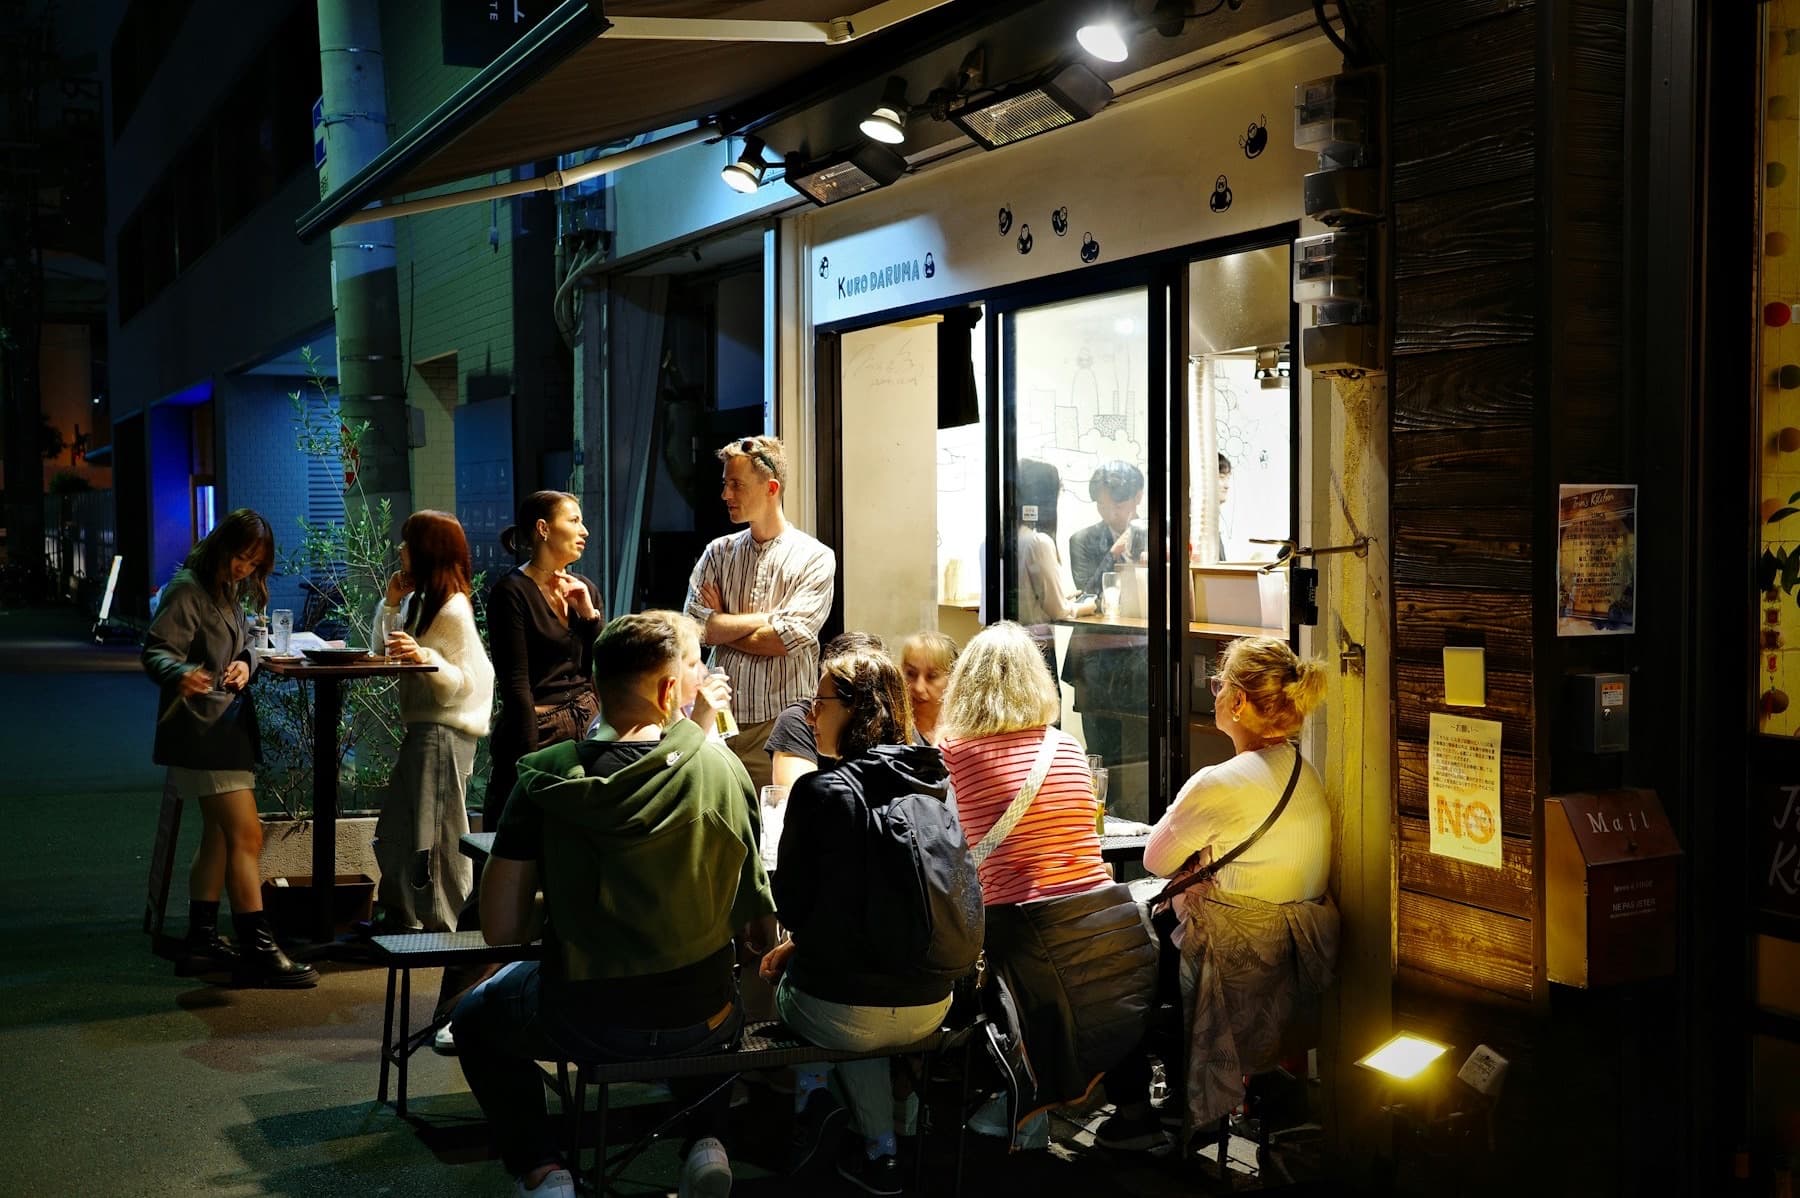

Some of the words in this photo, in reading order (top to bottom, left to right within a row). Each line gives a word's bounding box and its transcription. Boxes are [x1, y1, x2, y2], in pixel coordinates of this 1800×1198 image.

[870, 259, 920, 291] DARUMA
[1436, 795, 1496, 844] NO
[1585, 810, 1650, 833] Mail
